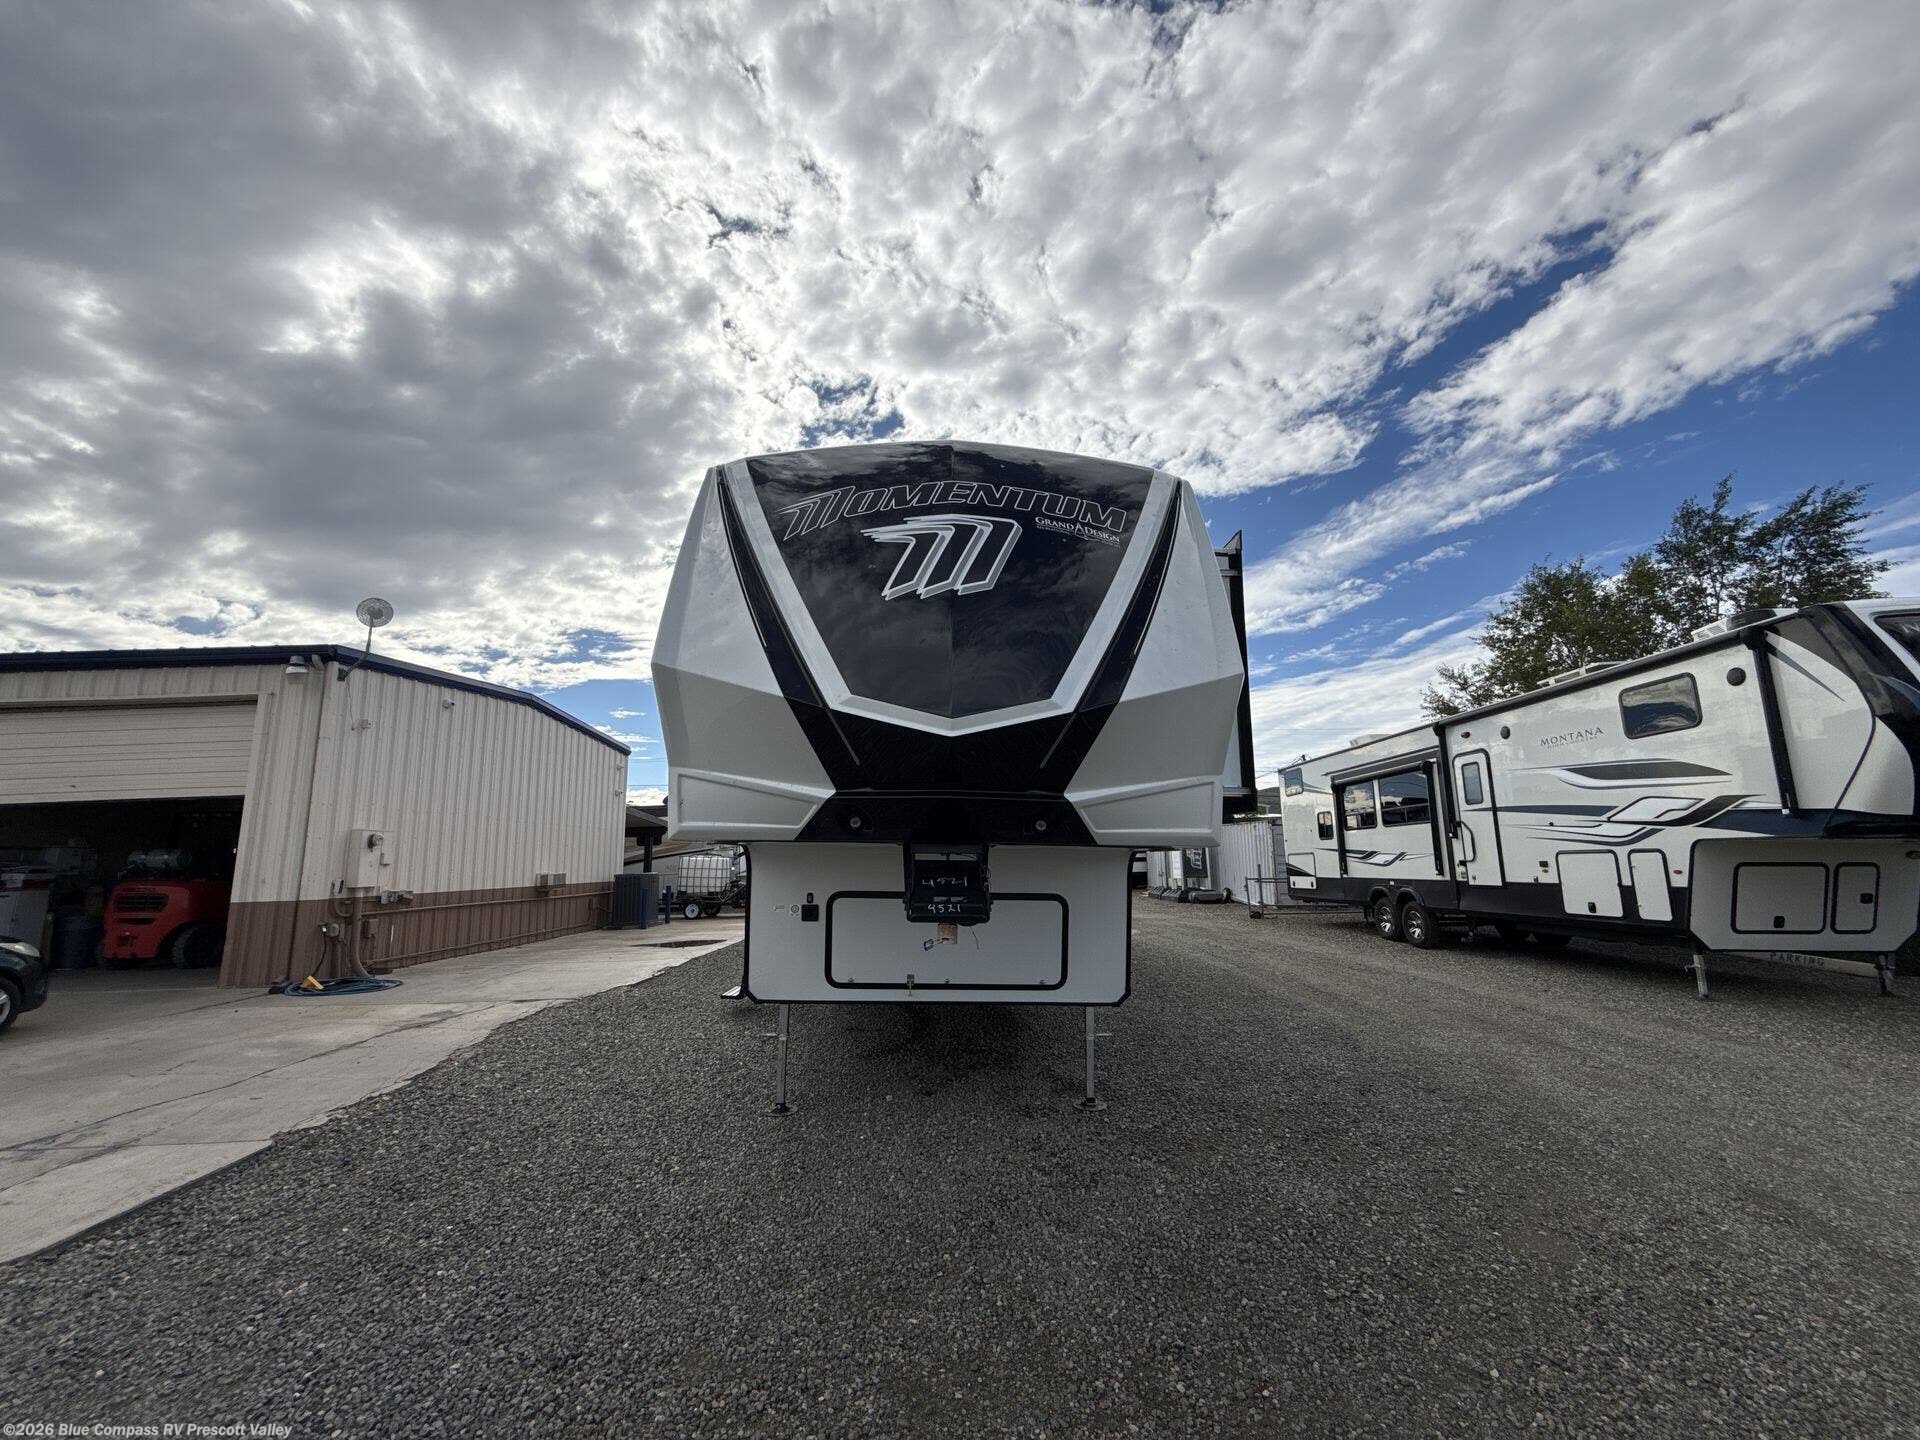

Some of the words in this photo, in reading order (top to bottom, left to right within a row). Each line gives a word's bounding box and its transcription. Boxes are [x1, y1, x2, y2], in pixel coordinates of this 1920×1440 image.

[775, 480, 1127, 541] MOMENTUM
[1034, 516, 1075, 530] GRAND
[1084, 526, 1121, 543] DESIGN
[1540, 727, 1604, 746] MONTANA
[921, 876, 968, 888] 4521
[927, 903, 961, 914] 4521
[1769, 951, 1825, 967] PARKING
